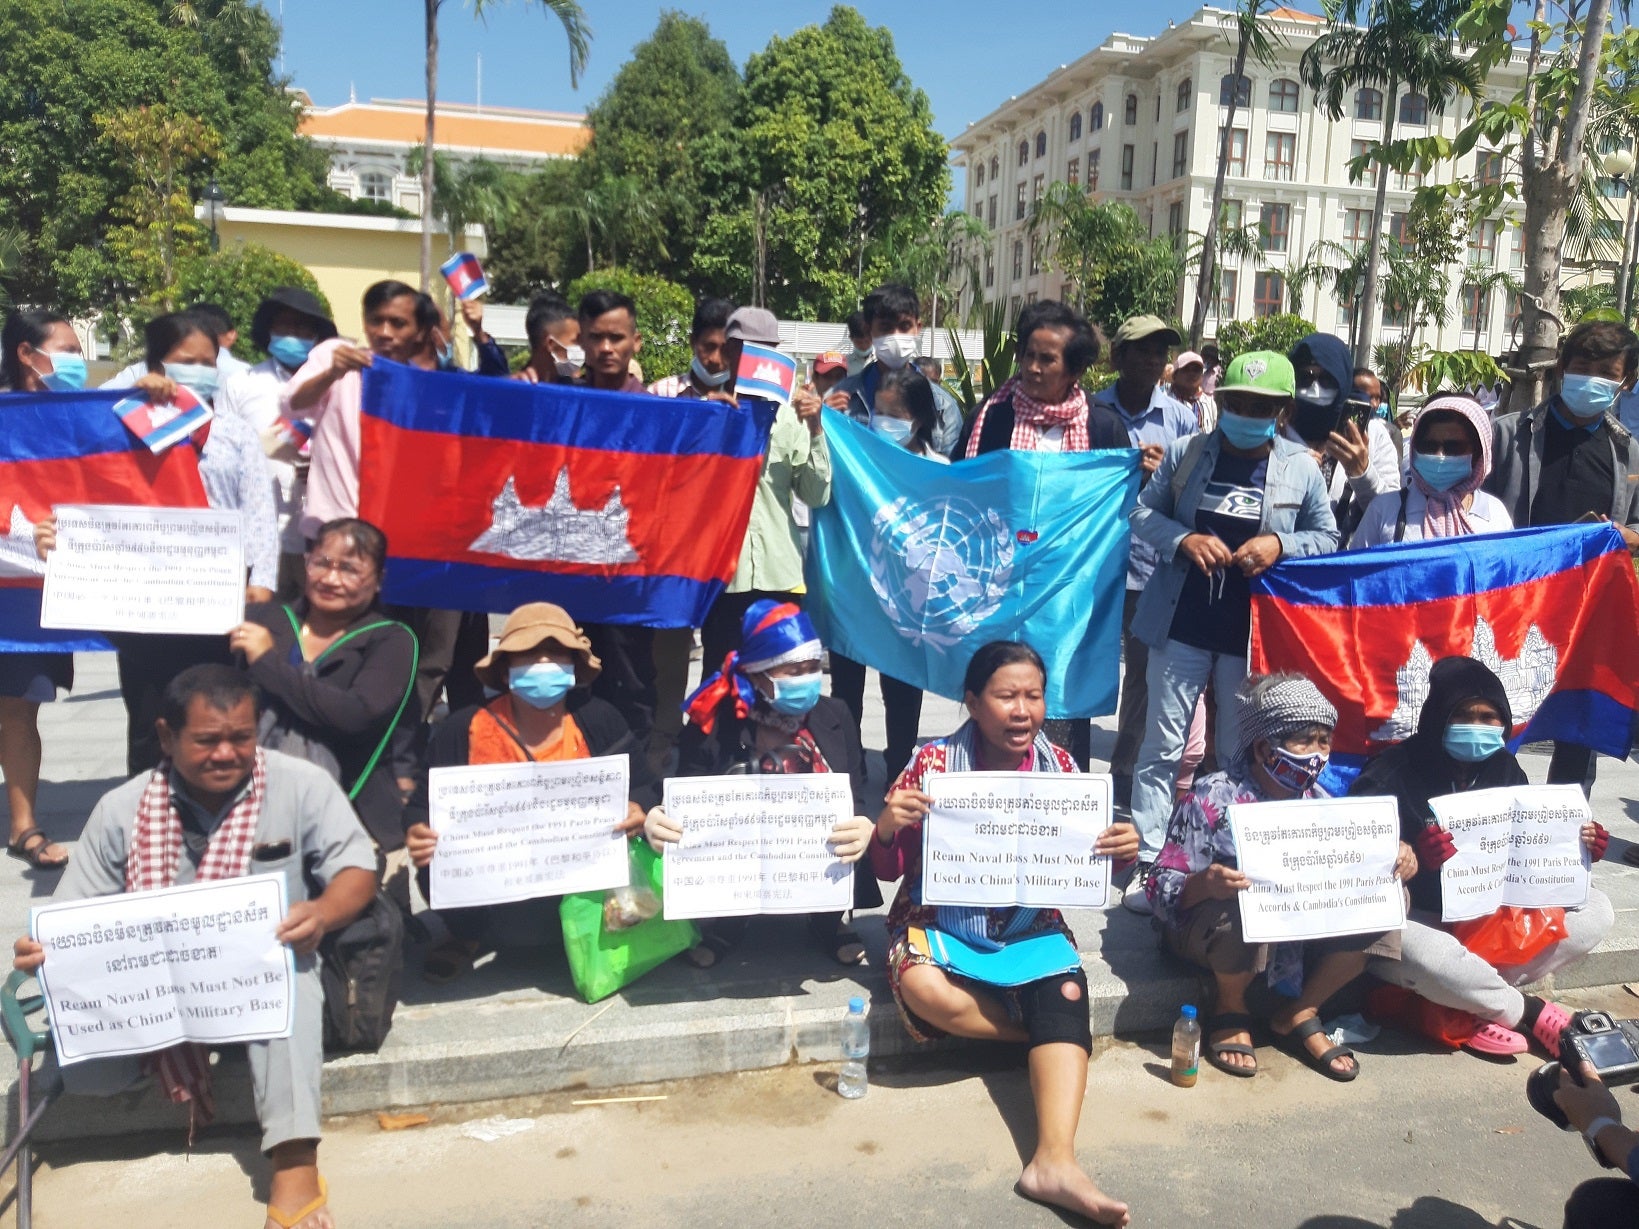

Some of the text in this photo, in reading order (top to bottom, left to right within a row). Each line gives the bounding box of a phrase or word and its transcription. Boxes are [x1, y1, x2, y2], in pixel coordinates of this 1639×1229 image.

[761, 837, 773, 845] the
[776, 837, 793, 845] 1991
[797, 837, 818, 845] Paris
[717, 852, 733, 861] and
[735, 852, 748, 860] the
[932, 850, 1103, 866] Ream Naval Bass Must Not Be
[1447, 865, 1469, 879] China
[1471, 863, 1490, 876] Must
[1507, 857, 1521, 867] the
[1524, 857, 1541, 868] 1991
[1543, 857, 1561, 868] Paris
[1563, 856, 1585, 866] Peace
[933, 872, 1101, 889] Used as China's Military Base
[1247, 875, 1394, 894] China Must Respect the 1991 Paris Peace
[1457, 881, 1486, 896] Accords
[1487, 880, 1493, 890] &
[1529, 874, 1575, 885] Constitution
[1258, 893, 1387, 913] Accords & Cambodia's Constitution
[60, 971, 283, 1012] Ream Naval Bass Must Not Be
[67, 1020, 104, 1036] Used
[109, 1020, 123, 1031] as
[186, 1004, 244, 1019] Military
[250, 998, 283, 1012] Base
